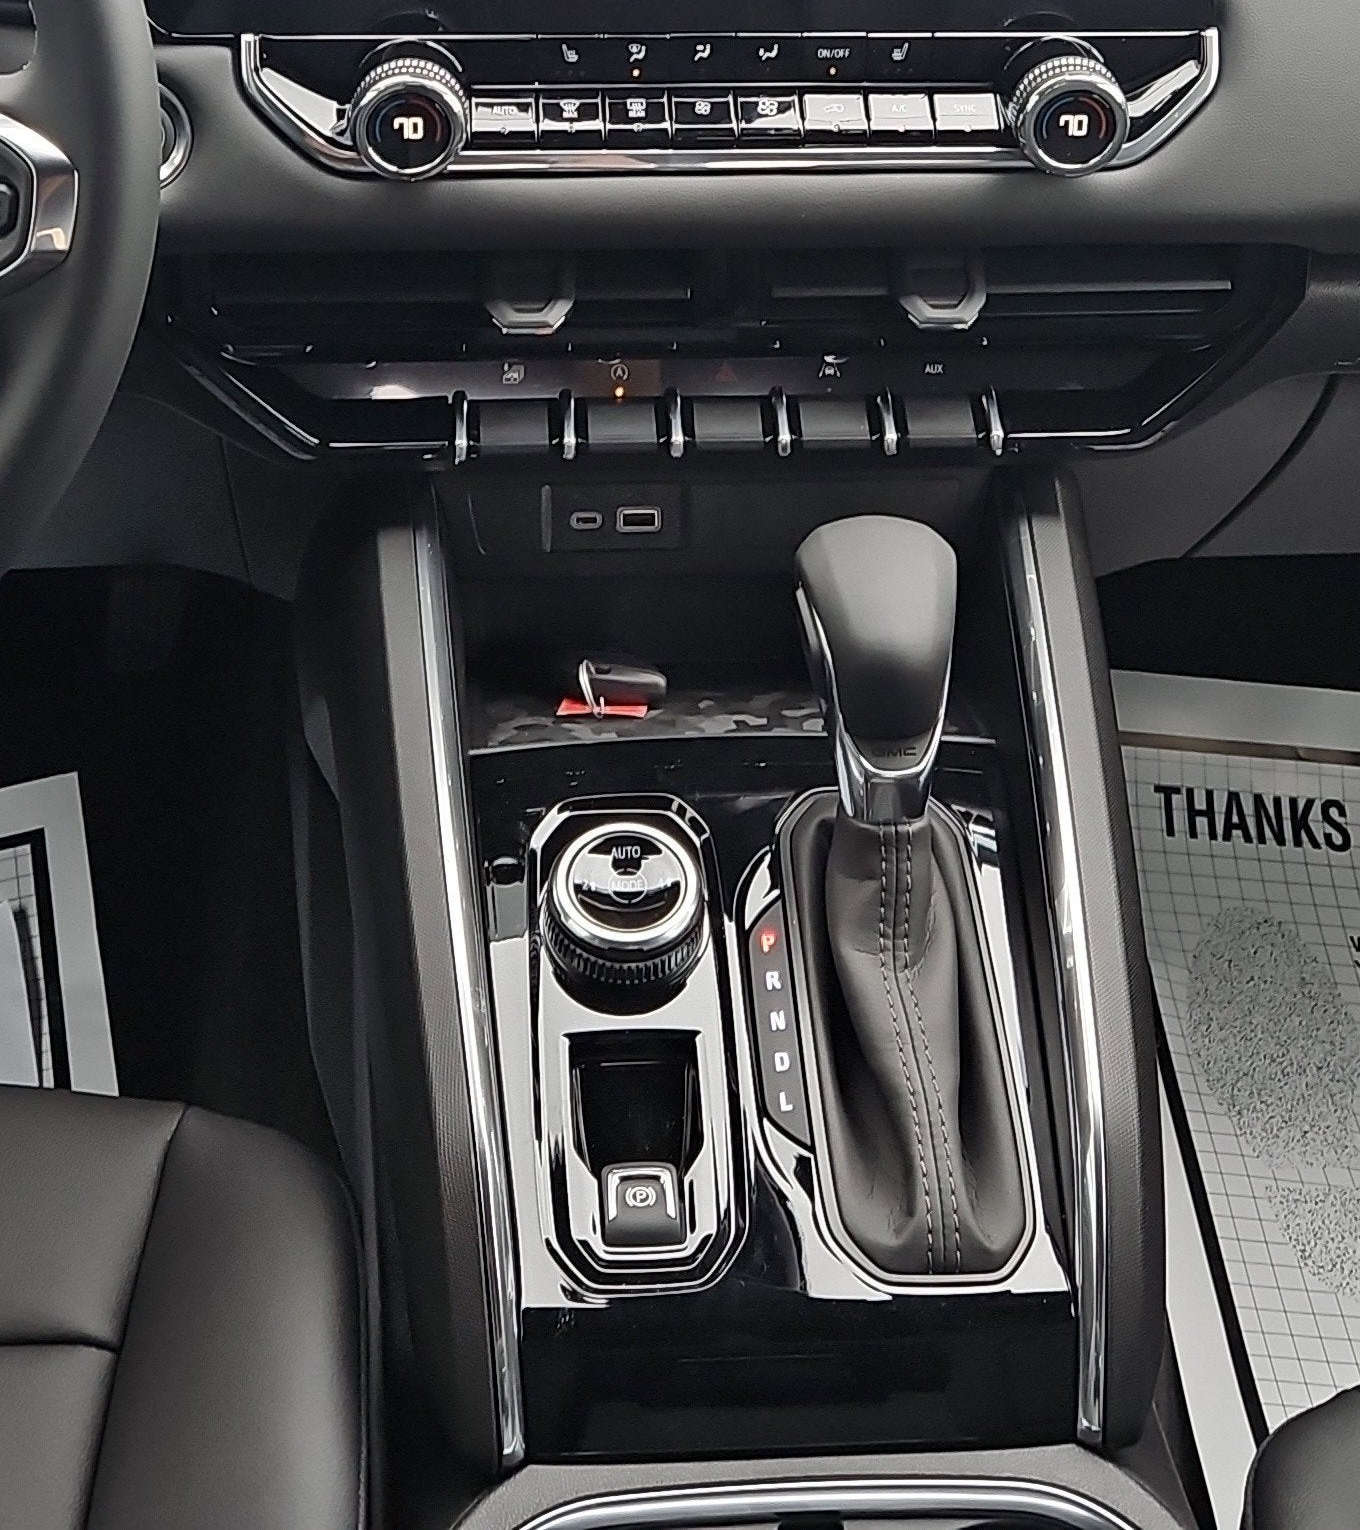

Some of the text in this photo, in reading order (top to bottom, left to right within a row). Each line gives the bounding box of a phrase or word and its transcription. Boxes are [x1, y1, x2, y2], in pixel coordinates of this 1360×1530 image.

[817, 48, 850, 59] ON/OFF
[393, 117, 424, 140] 70
[1059, 114, 1088, 137] 70
[924, 364, 944, 375] AUX
[1154, 784, 1351, 853] THANKS
[612, 845, 641, 860] AUTO
[611, 879, 643, 891] MODE
[761, 933, 776, 953] P
[765, 971, 781, 991] R
[770, 1010, 786, 1031] N
[774, 1052, 790, 1072] D
[779, 1091, 793, 1112] L
